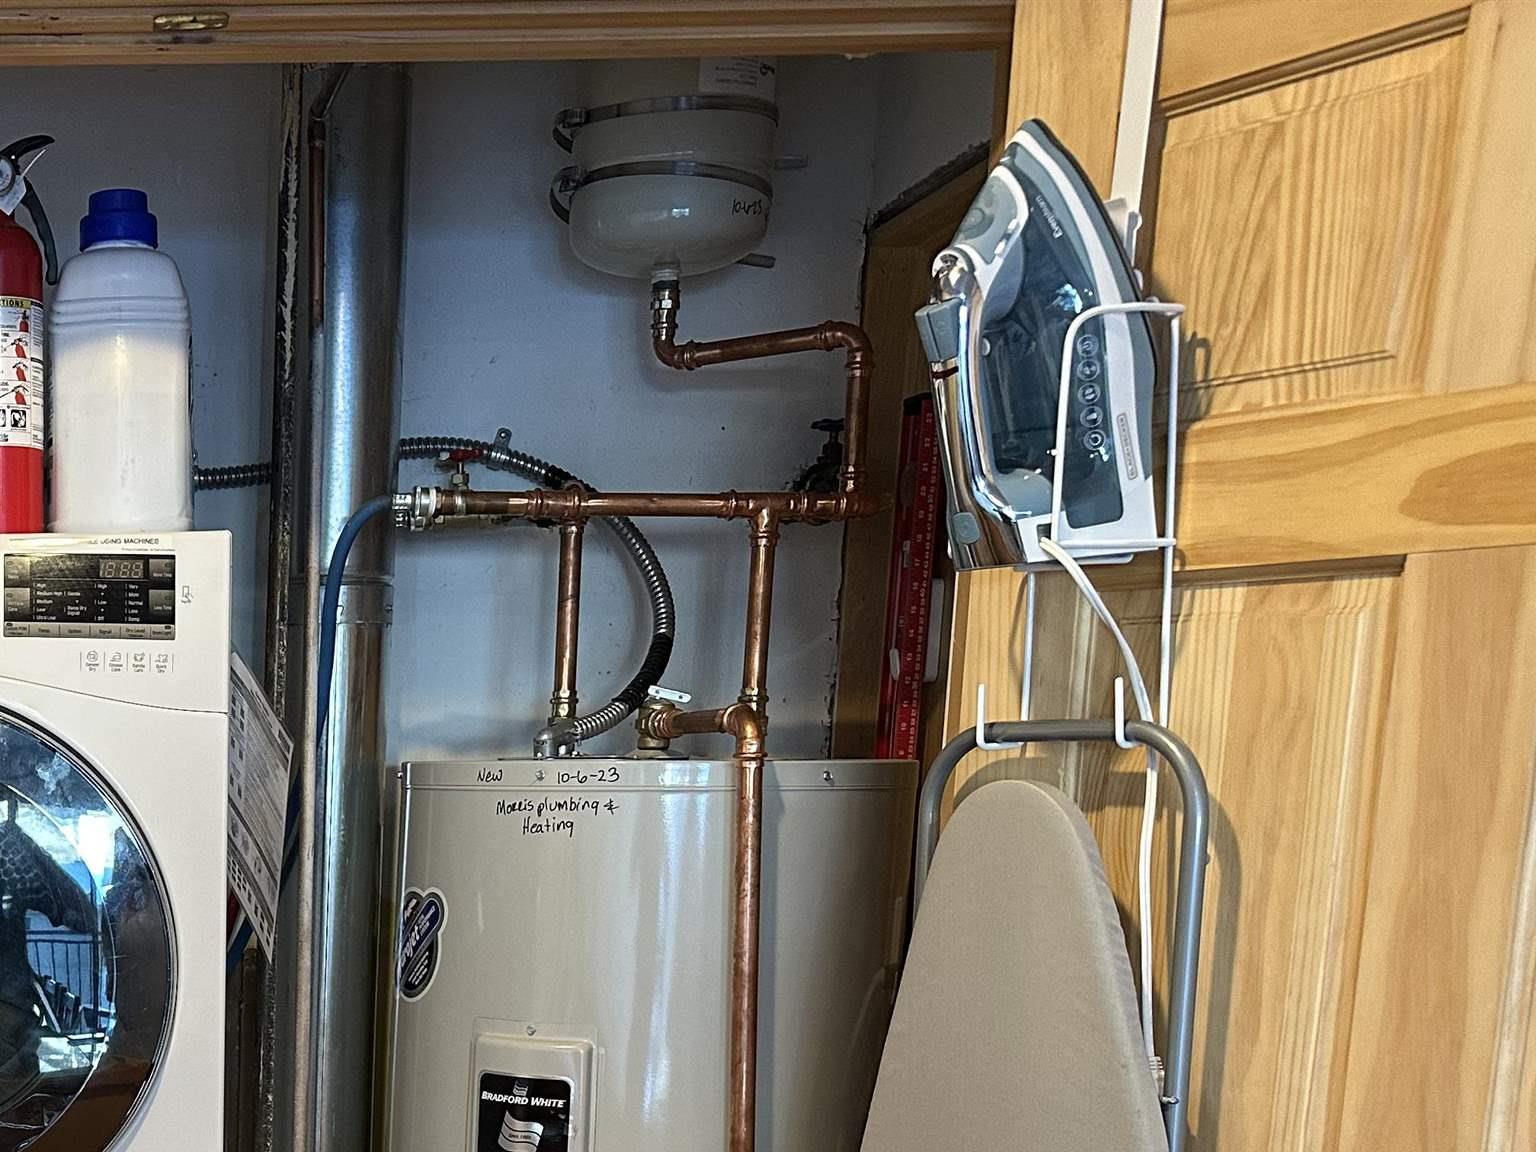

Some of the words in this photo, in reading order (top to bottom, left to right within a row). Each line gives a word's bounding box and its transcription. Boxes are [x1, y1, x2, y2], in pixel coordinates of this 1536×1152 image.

[476, 767, 503, 783] New
[557, 766, 620, 785] 10-6-23
[536, 796, 600, 817] plumbing
[522, 815, 574, 838] Heating
[481, 1090, 529, 1105] BRADFORD
[530, 1096, 567, 1108] WHITE
